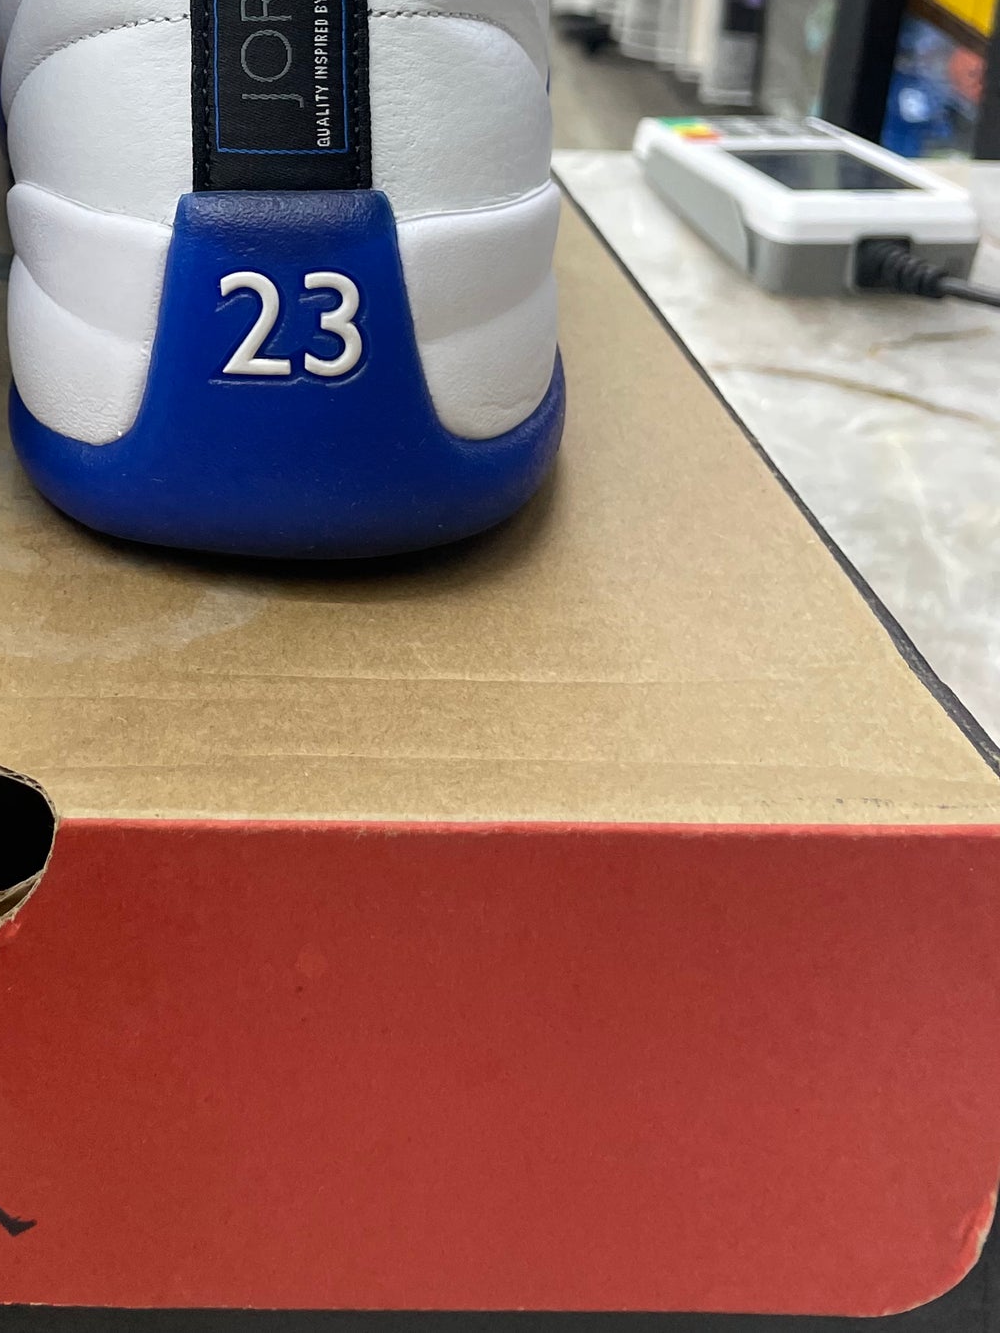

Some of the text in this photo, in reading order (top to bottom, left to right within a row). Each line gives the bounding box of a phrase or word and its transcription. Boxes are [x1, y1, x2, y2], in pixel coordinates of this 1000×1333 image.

[314, 19, 329, 79] INSPIRED
[315, 85, 331, 147] QUALITY
[220, 271, 363, 377] 23
